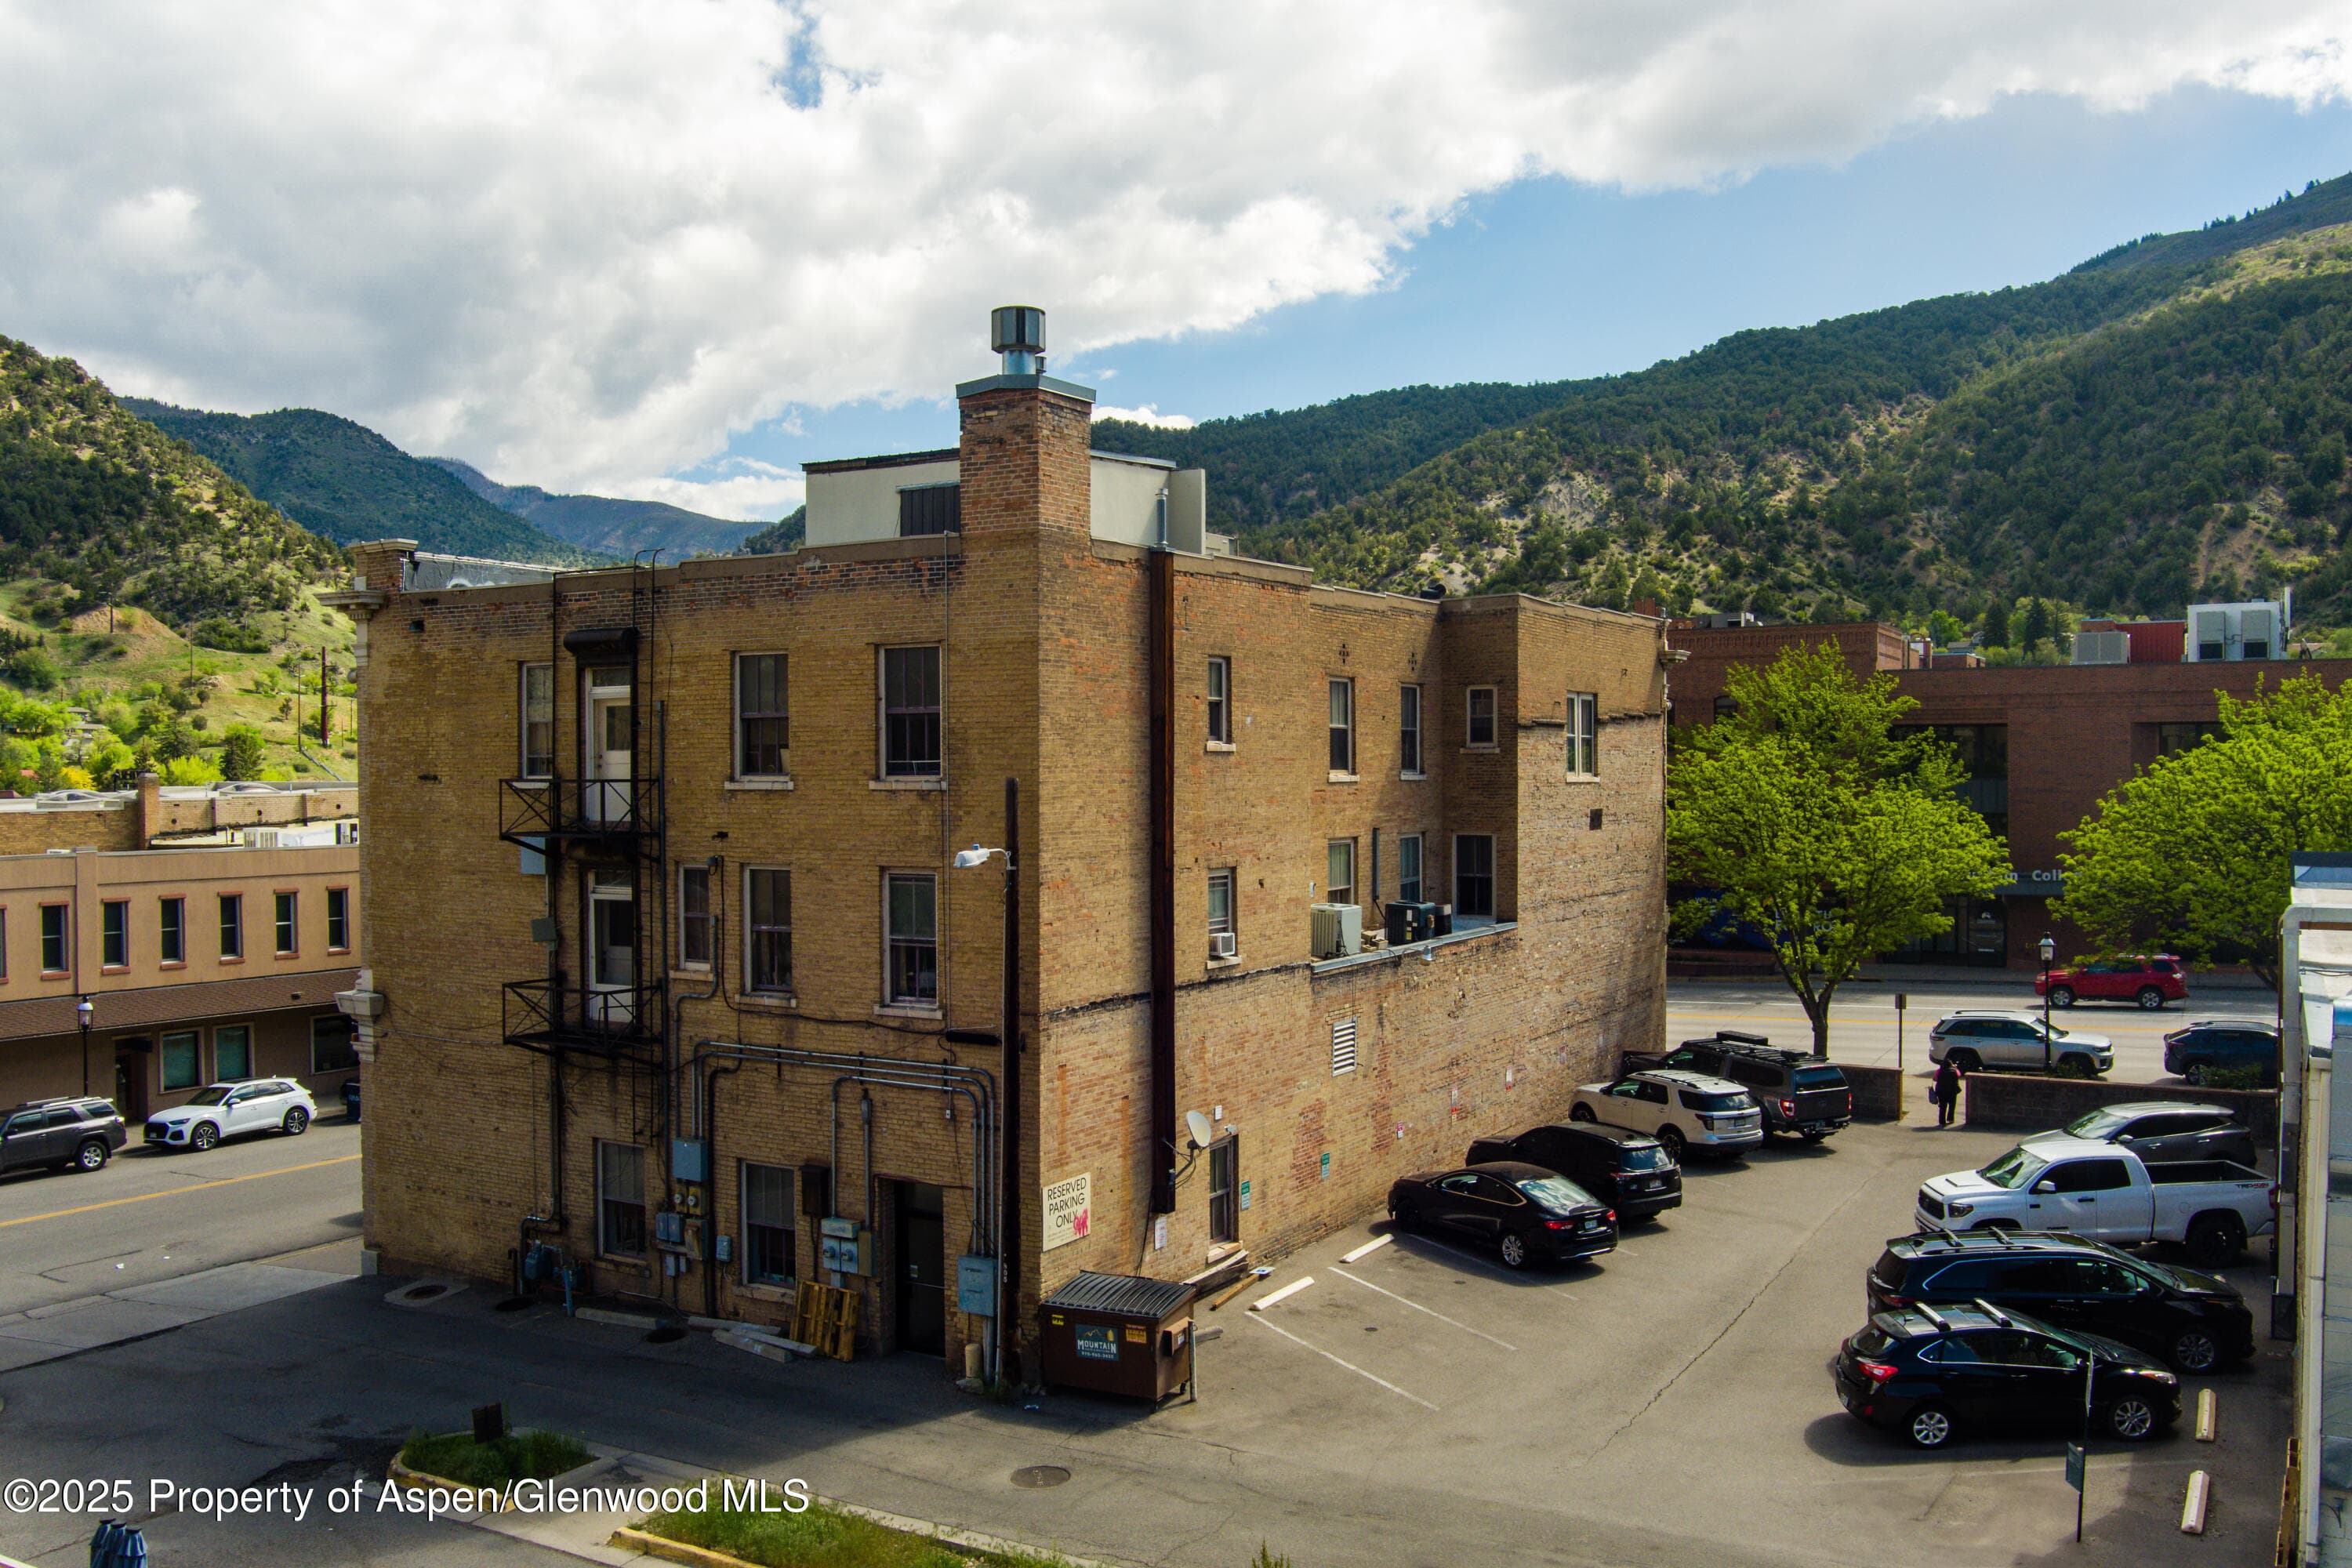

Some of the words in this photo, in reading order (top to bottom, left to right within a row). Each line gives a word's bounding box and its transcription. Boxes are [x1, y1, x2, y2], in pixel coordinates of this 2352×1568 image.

[2031, 869, 2083, 882] Coll
[1047, 1177, 1087, 1202] RESERVED
[1049, 1192, 1085, 1216] PARKING
[1077, 1339, 1117, 1354] MOUNTAIN
